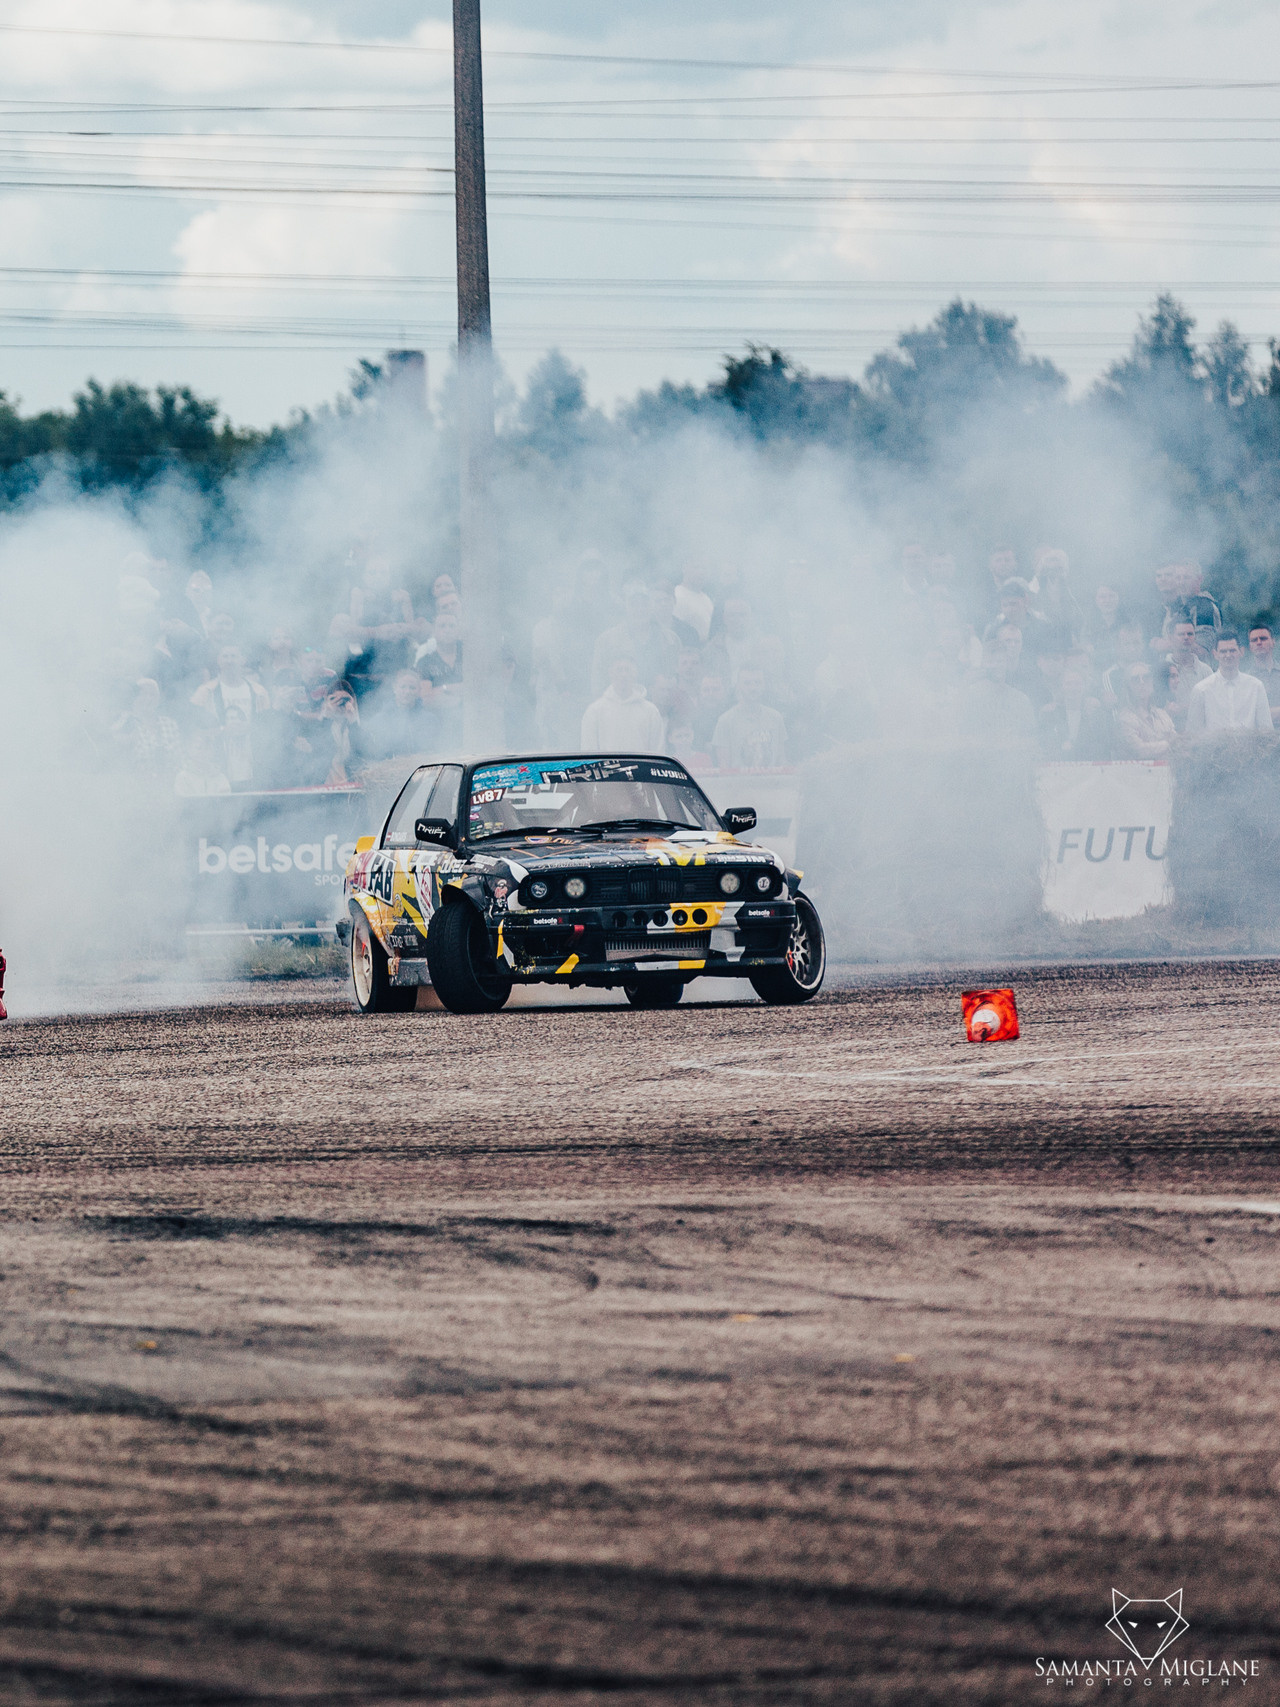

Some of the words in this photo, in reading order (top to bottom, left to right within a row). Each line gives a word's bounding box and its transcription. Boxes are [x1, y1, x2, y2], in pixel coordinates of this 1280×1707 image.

[472, 788, 503, 805] LV87
[198, 833, 359, 875] betsafe
[314, 874, 347, 887] SPO
